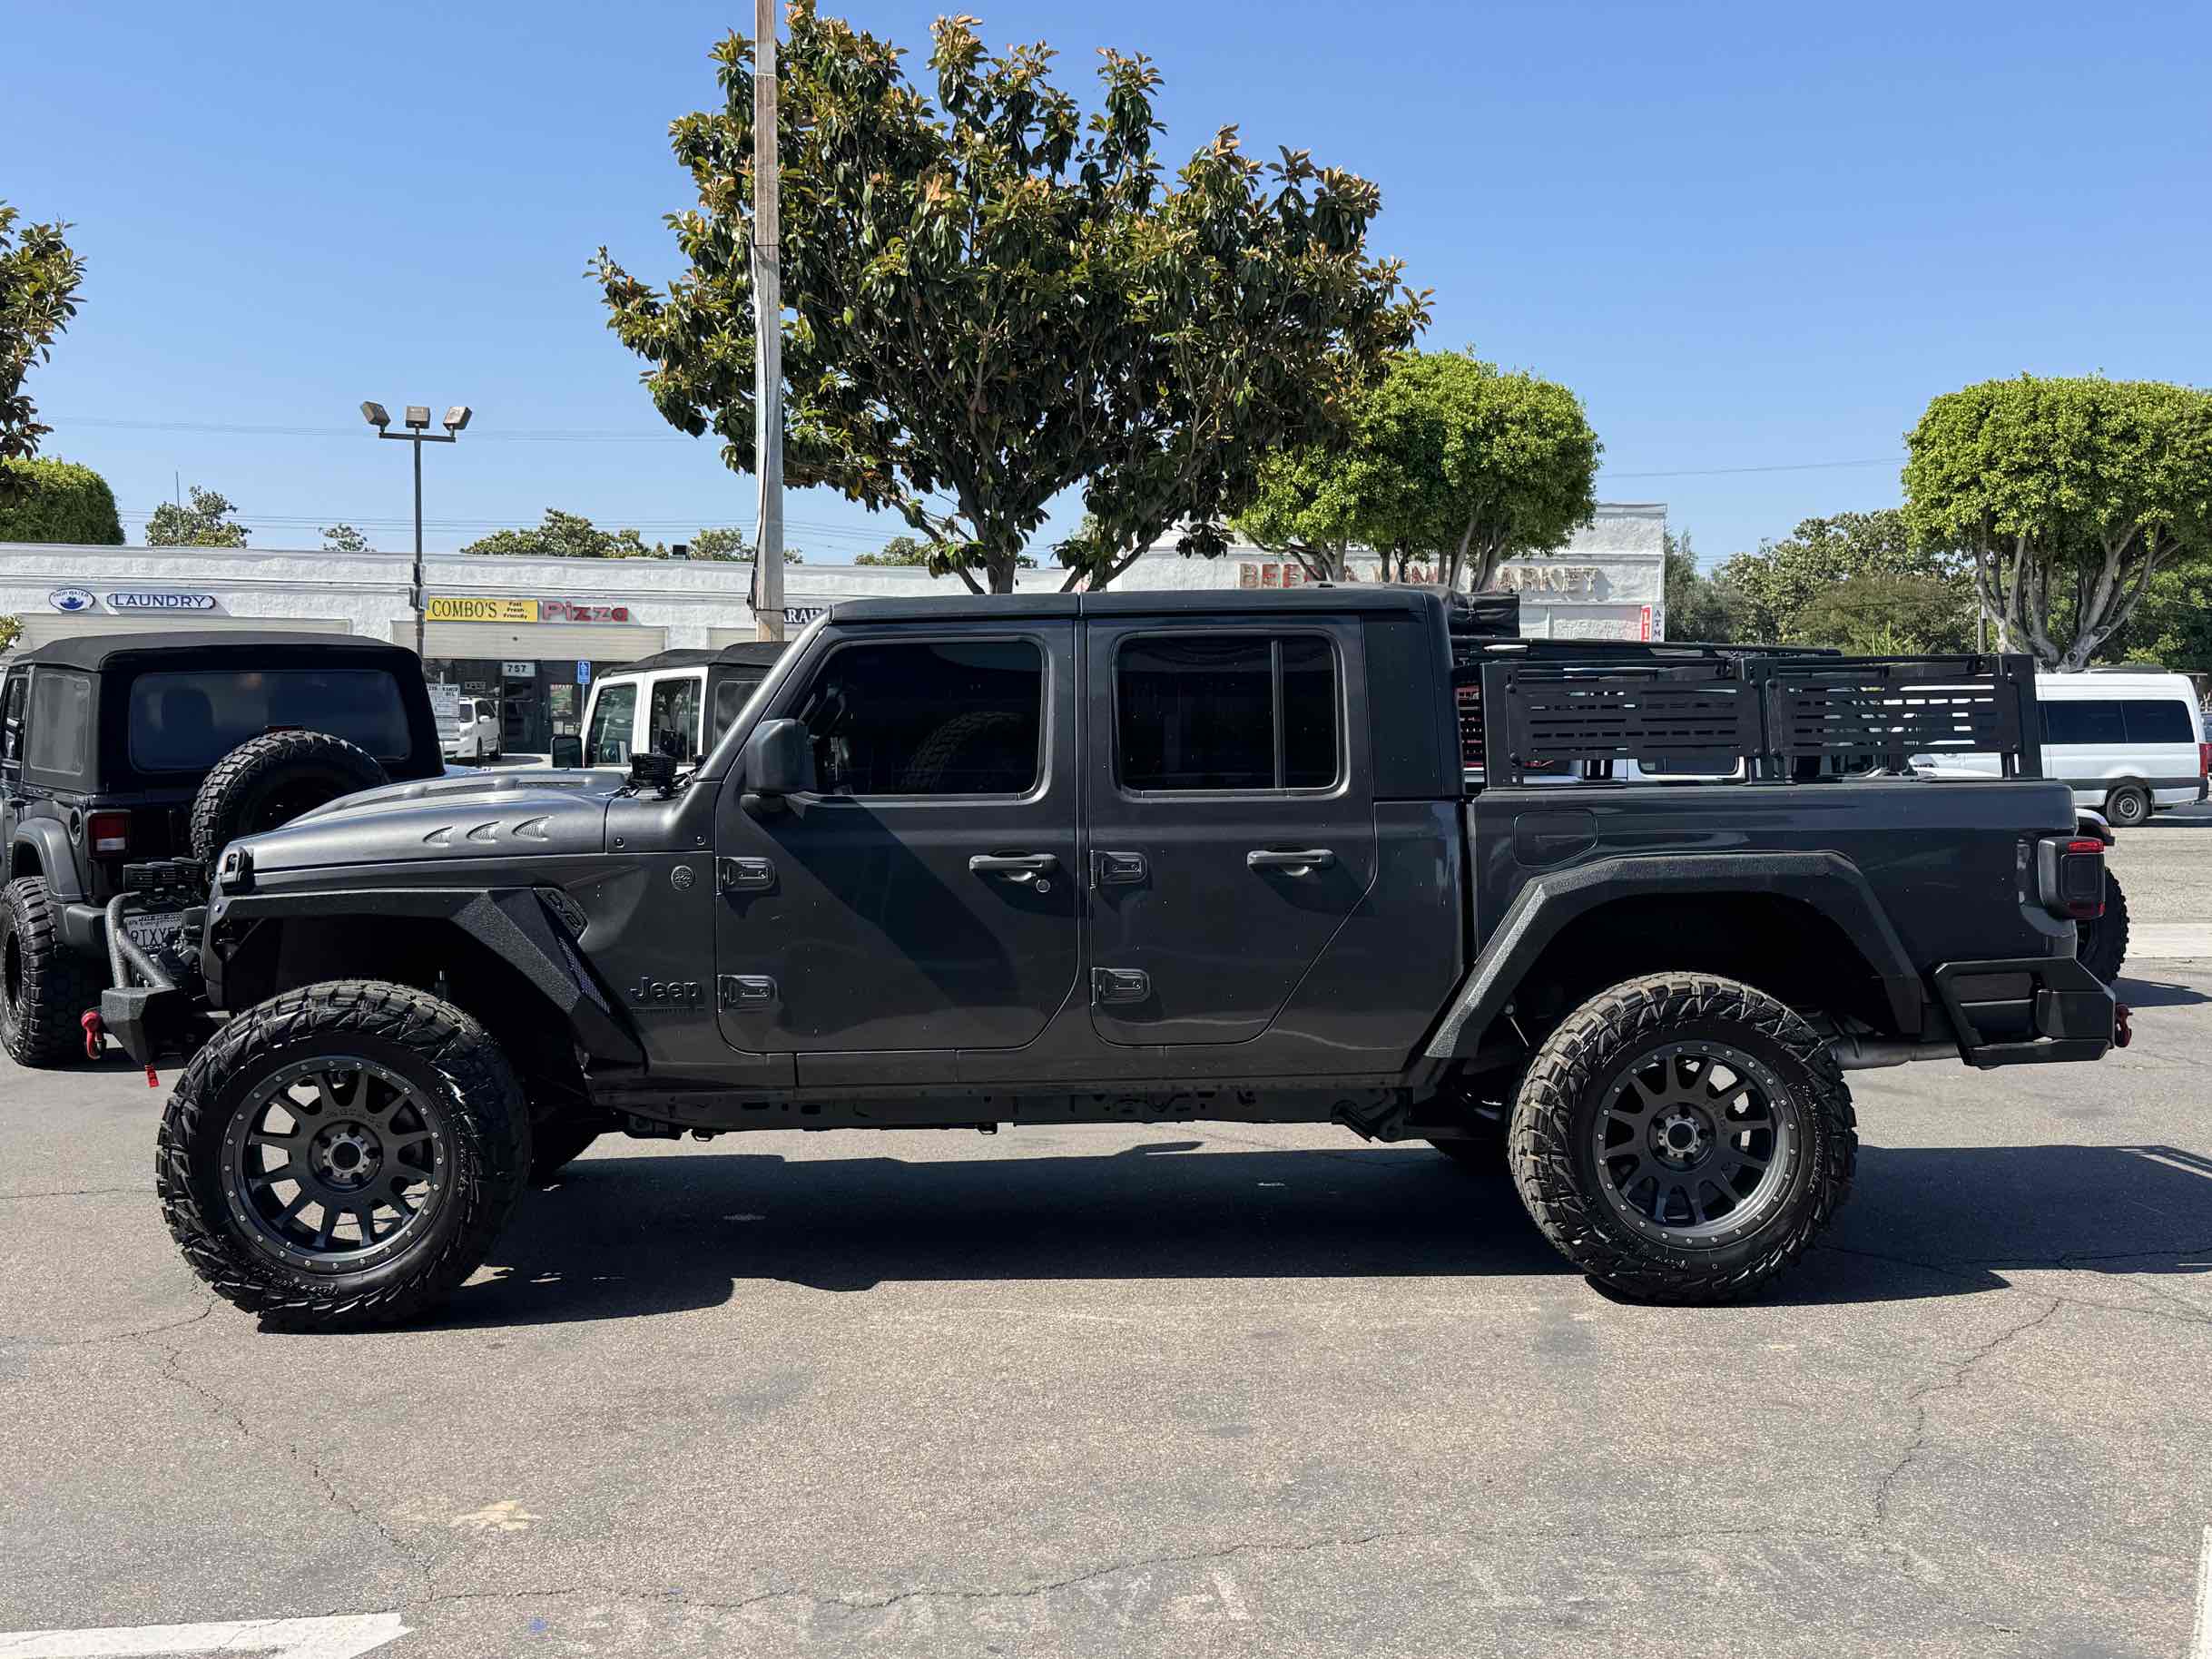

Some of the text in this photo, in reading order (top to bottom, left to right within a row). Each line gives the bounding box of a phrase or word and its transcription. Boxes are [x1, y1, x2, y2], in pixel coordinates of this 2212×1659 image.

[1469, 565, 1598, 592] ARKET
[115, 594, 205, 607] LAUNDRY
[431, 599, 497, 618] COMBO'S
[543, 601, 629, 622] Pizza
[507, 664, 526, 672] 757
[630, 976, 703, 1004] Jeep
